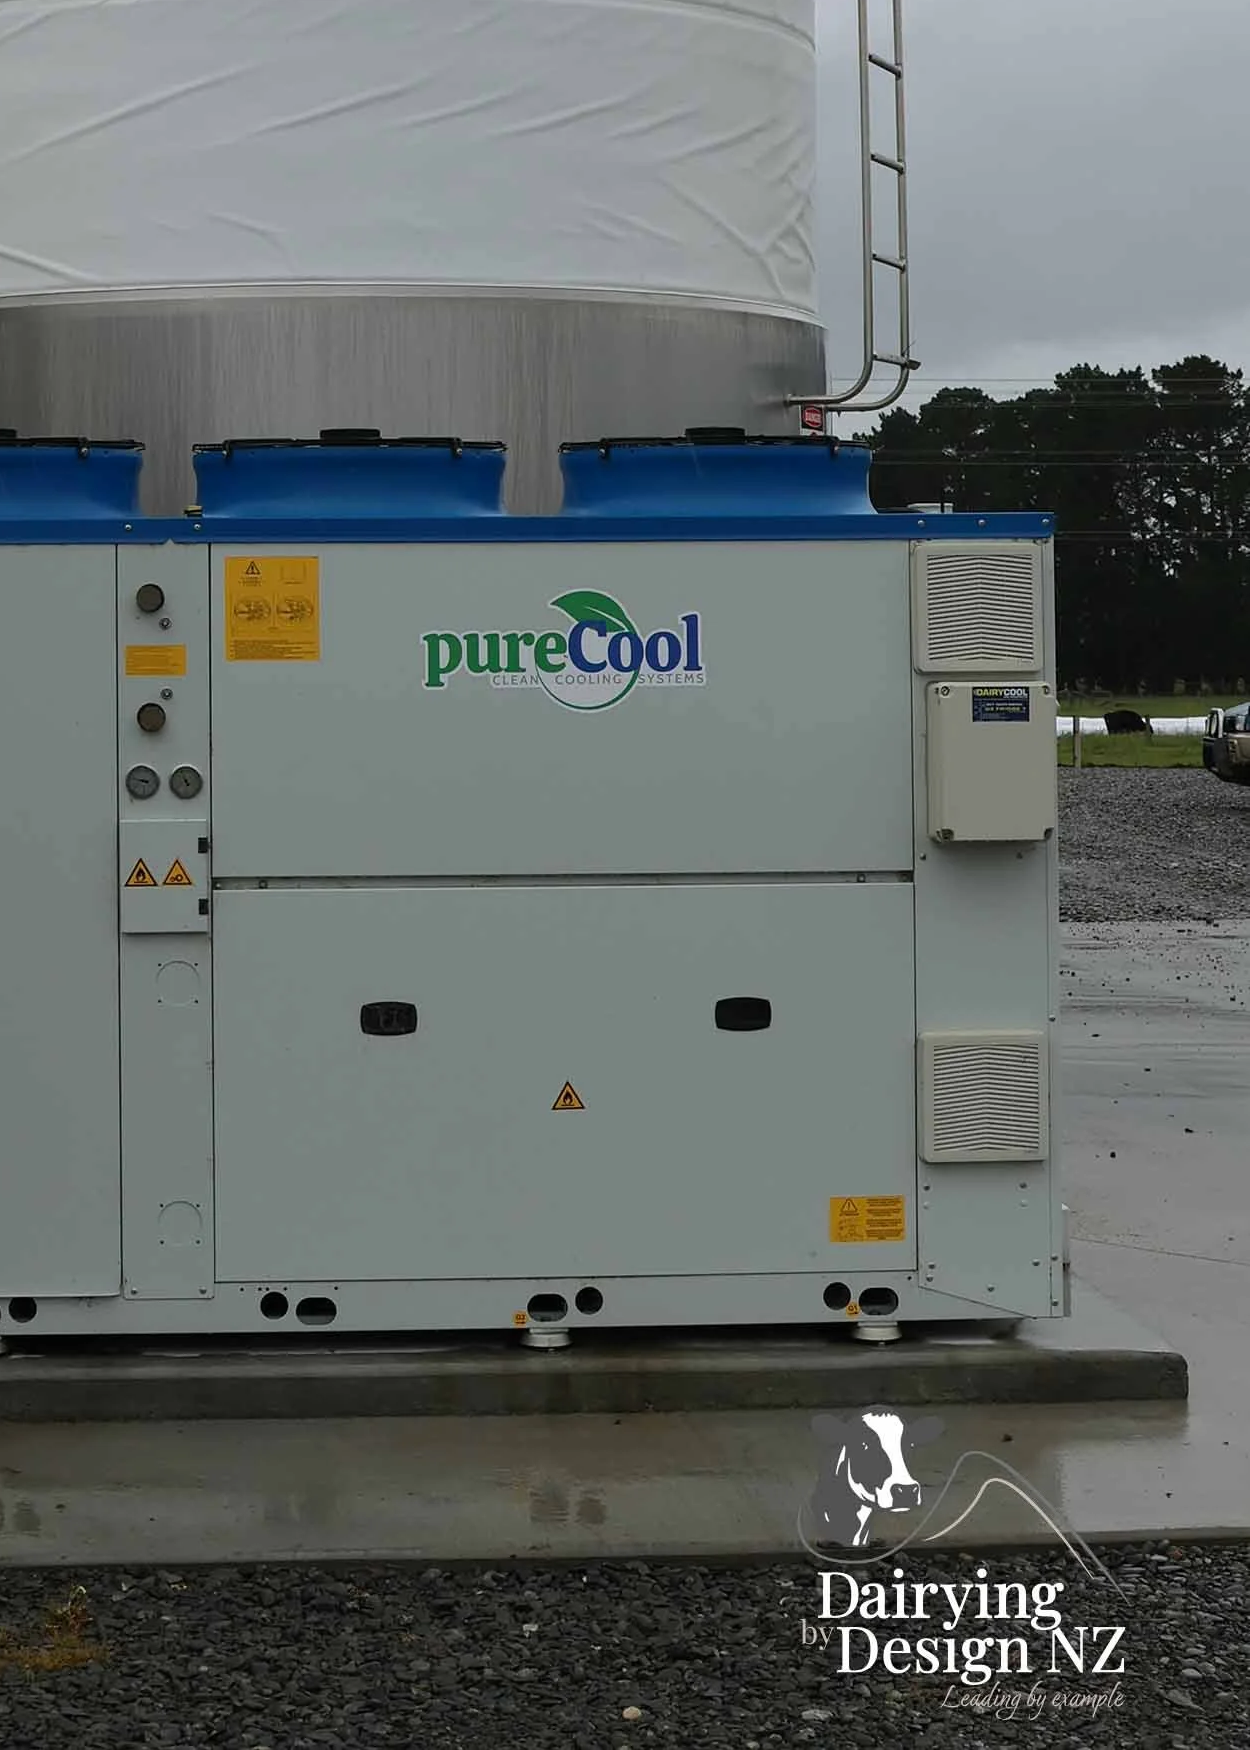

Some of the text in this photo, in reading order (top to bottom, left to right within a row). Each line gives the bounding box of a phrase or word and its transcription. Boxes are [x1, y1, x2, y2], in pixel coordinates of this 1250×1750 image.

[422, 613, 703, 687] pureCool
[492, 673, 705, 686] CLEAN COOLING SYSTEMS
